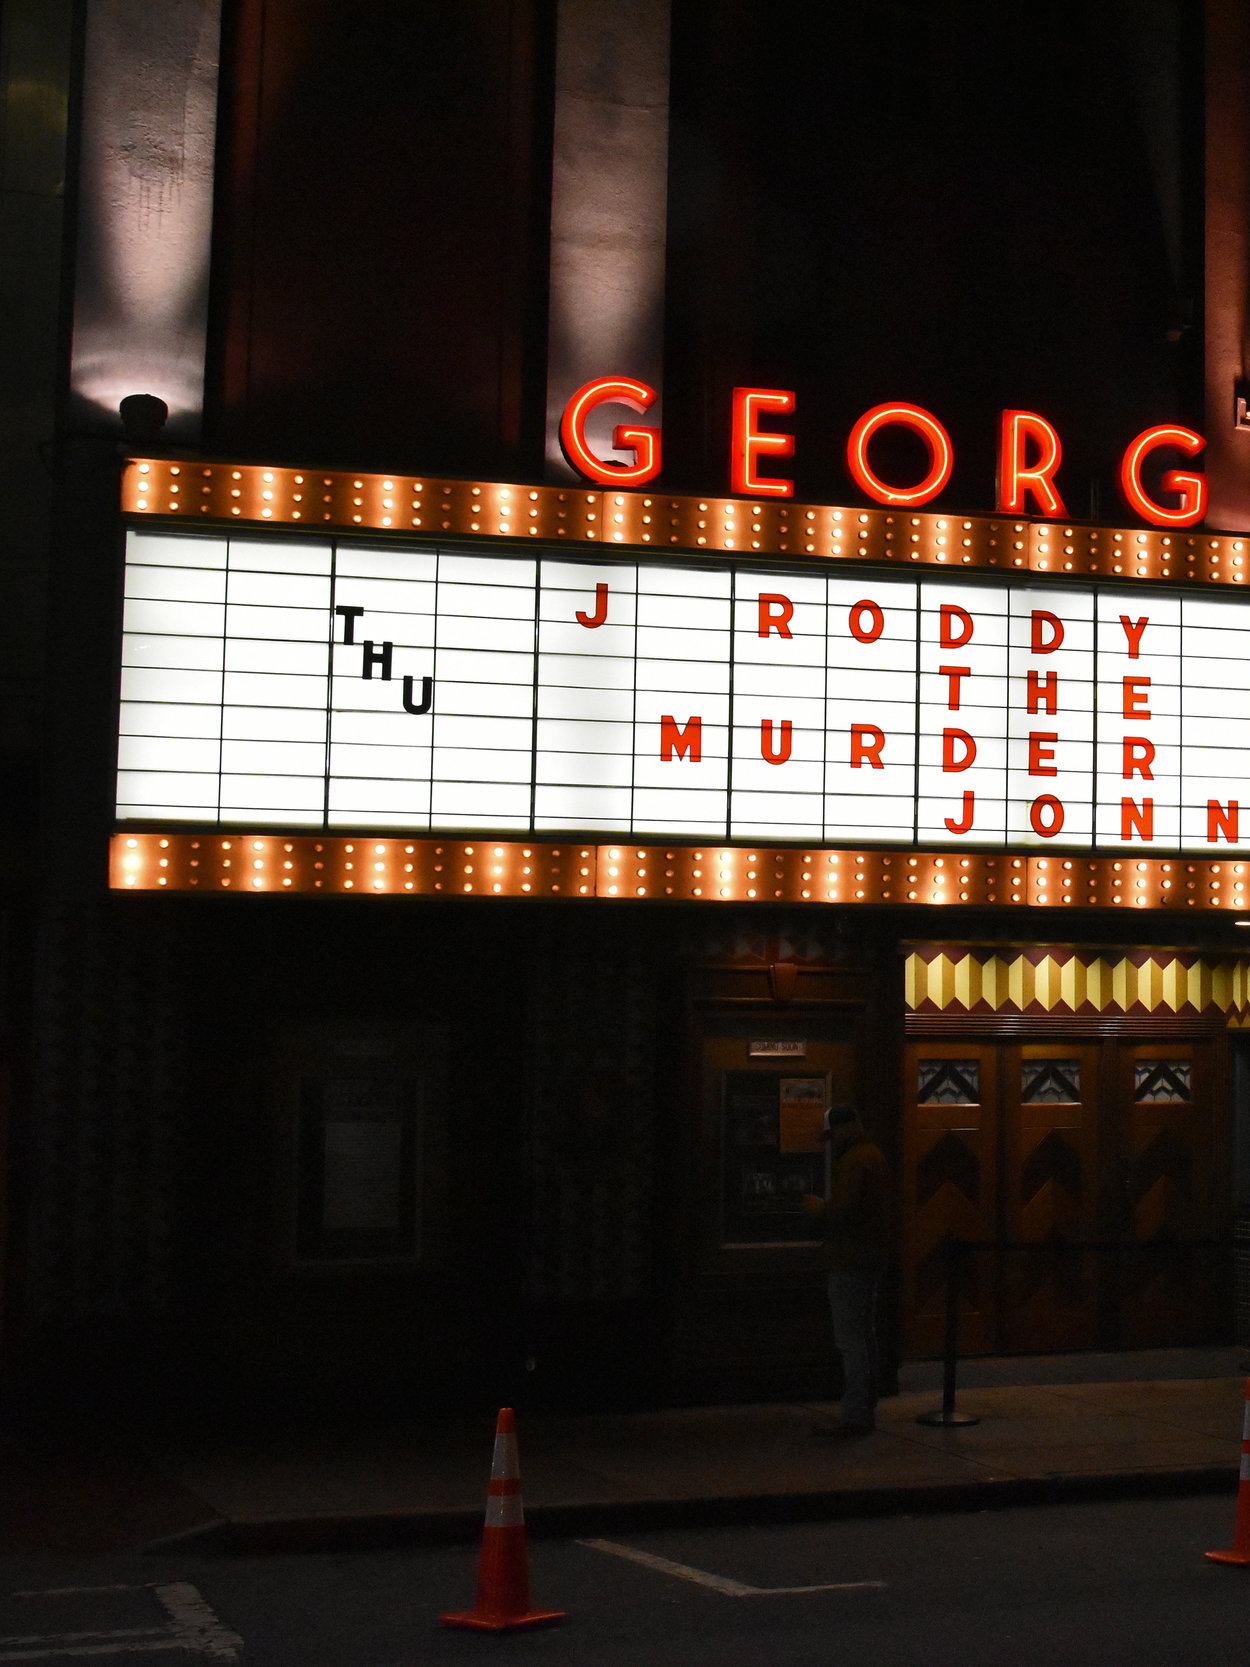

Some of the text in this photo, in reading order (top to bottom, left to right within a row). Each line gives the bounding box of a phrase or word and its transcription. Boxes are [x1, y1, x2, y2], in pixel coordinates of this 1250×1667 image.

[576, 584, 609, 628] J
[759, 593, 1149, 659] RODDY
[336, 606, 433, 714] THU
[940, 666, 1151, 720] THE
[661, 716, 1155, 780] MURDER
